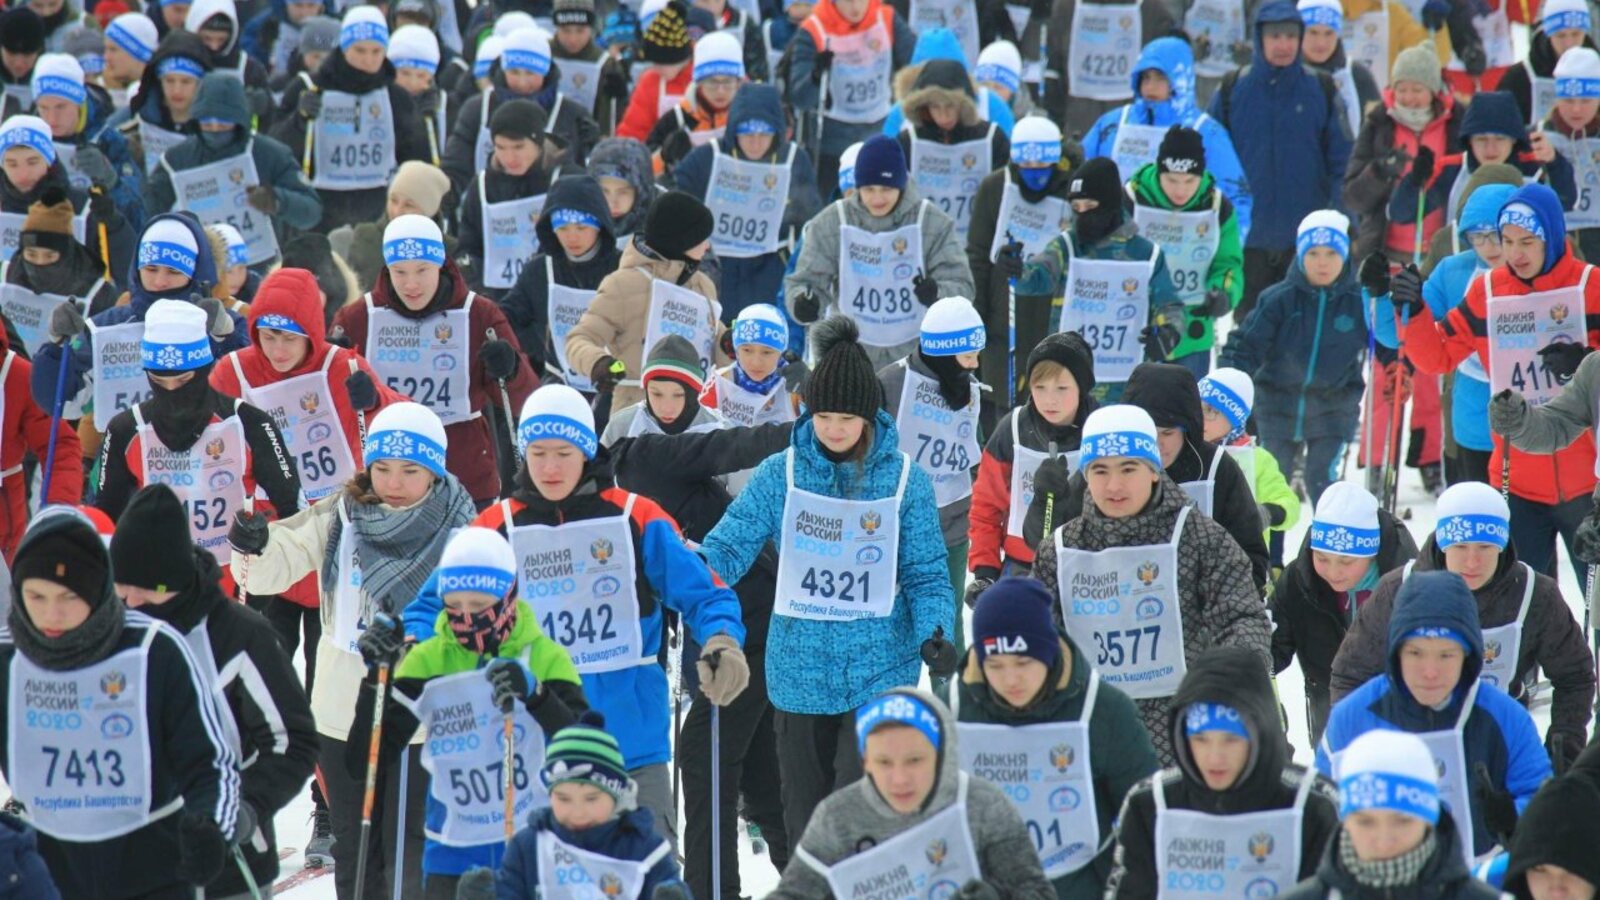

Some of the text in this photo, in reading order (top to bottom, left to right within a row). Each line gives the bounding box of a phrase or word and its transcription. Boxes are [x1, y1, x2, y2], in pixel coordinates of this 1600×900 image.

[1082, 55, 1128, 77] 4220
[330, 144, 382, 168] 4056
[718, 213, 768, 243] 5093
[852, 286, 913, 314] 4038
[1497, 312, 1535, 324] ЛЫЖНЯ
[378, 326, 420, 337] ЛЫЖНЯ
[1497, 323, 1536, 335] РОССИИ
[378, 337, 420, 348] РОССИИ
[923, 337, 967, 350] ЛЫЖНЯ
[387, 377, 451, 407] 5224
[524, 421, 580, 443] РОССИИ
[262, 423, 293, 480] PELTONEN
[915, 433, 970, 472] 7848
[148, 459, 191, 471] РОССИИ
[297, 446, 337, 482] 56
[184, 496, 227, 532] 52
[796, 510, 843, 530] ЛЫЖНЯ
[796, 521, 842, 542] РОССИИ
[794, 536, 842, 557] 2020
[523, 549, 572, 568] ЛЫЖНЯ
[525, 563, 573, 582] РОССИИ
[1072, 572, 1118, 588] ЛЫЖНЯ
[526, 578, 576, 599] 2020
[801, 567, 870, 603] 4321
[1072, 584, 1119, 600] РОССИИ
[1072, 600, 1121, 616] 2020
[542, 603, 617, 647] 1342
[982, 635, 1028, 655] FILA
[1093, 625, 1161, 667] 3577
[24, 679, 78, 696] ЛЫЖНЯ
[25, 694, 80, 711] РОССИИ
[26, 710, 82, 731] 2020
[430, 733, 480, 757] 2020
[42, 745, 126, 788] 7413
[973, 752, 1028, 767] ЛЫЖНЯ
[449, 753, 529, 806] 5078
[1167, 837, 1226, 854] ЛЫЖНЯ
[1167, 854, 1225, 870] РОССИИ
[853, 864, 910, 898] ЛЫЖНЯ
[1167, 872, 1226, 892] 2020
